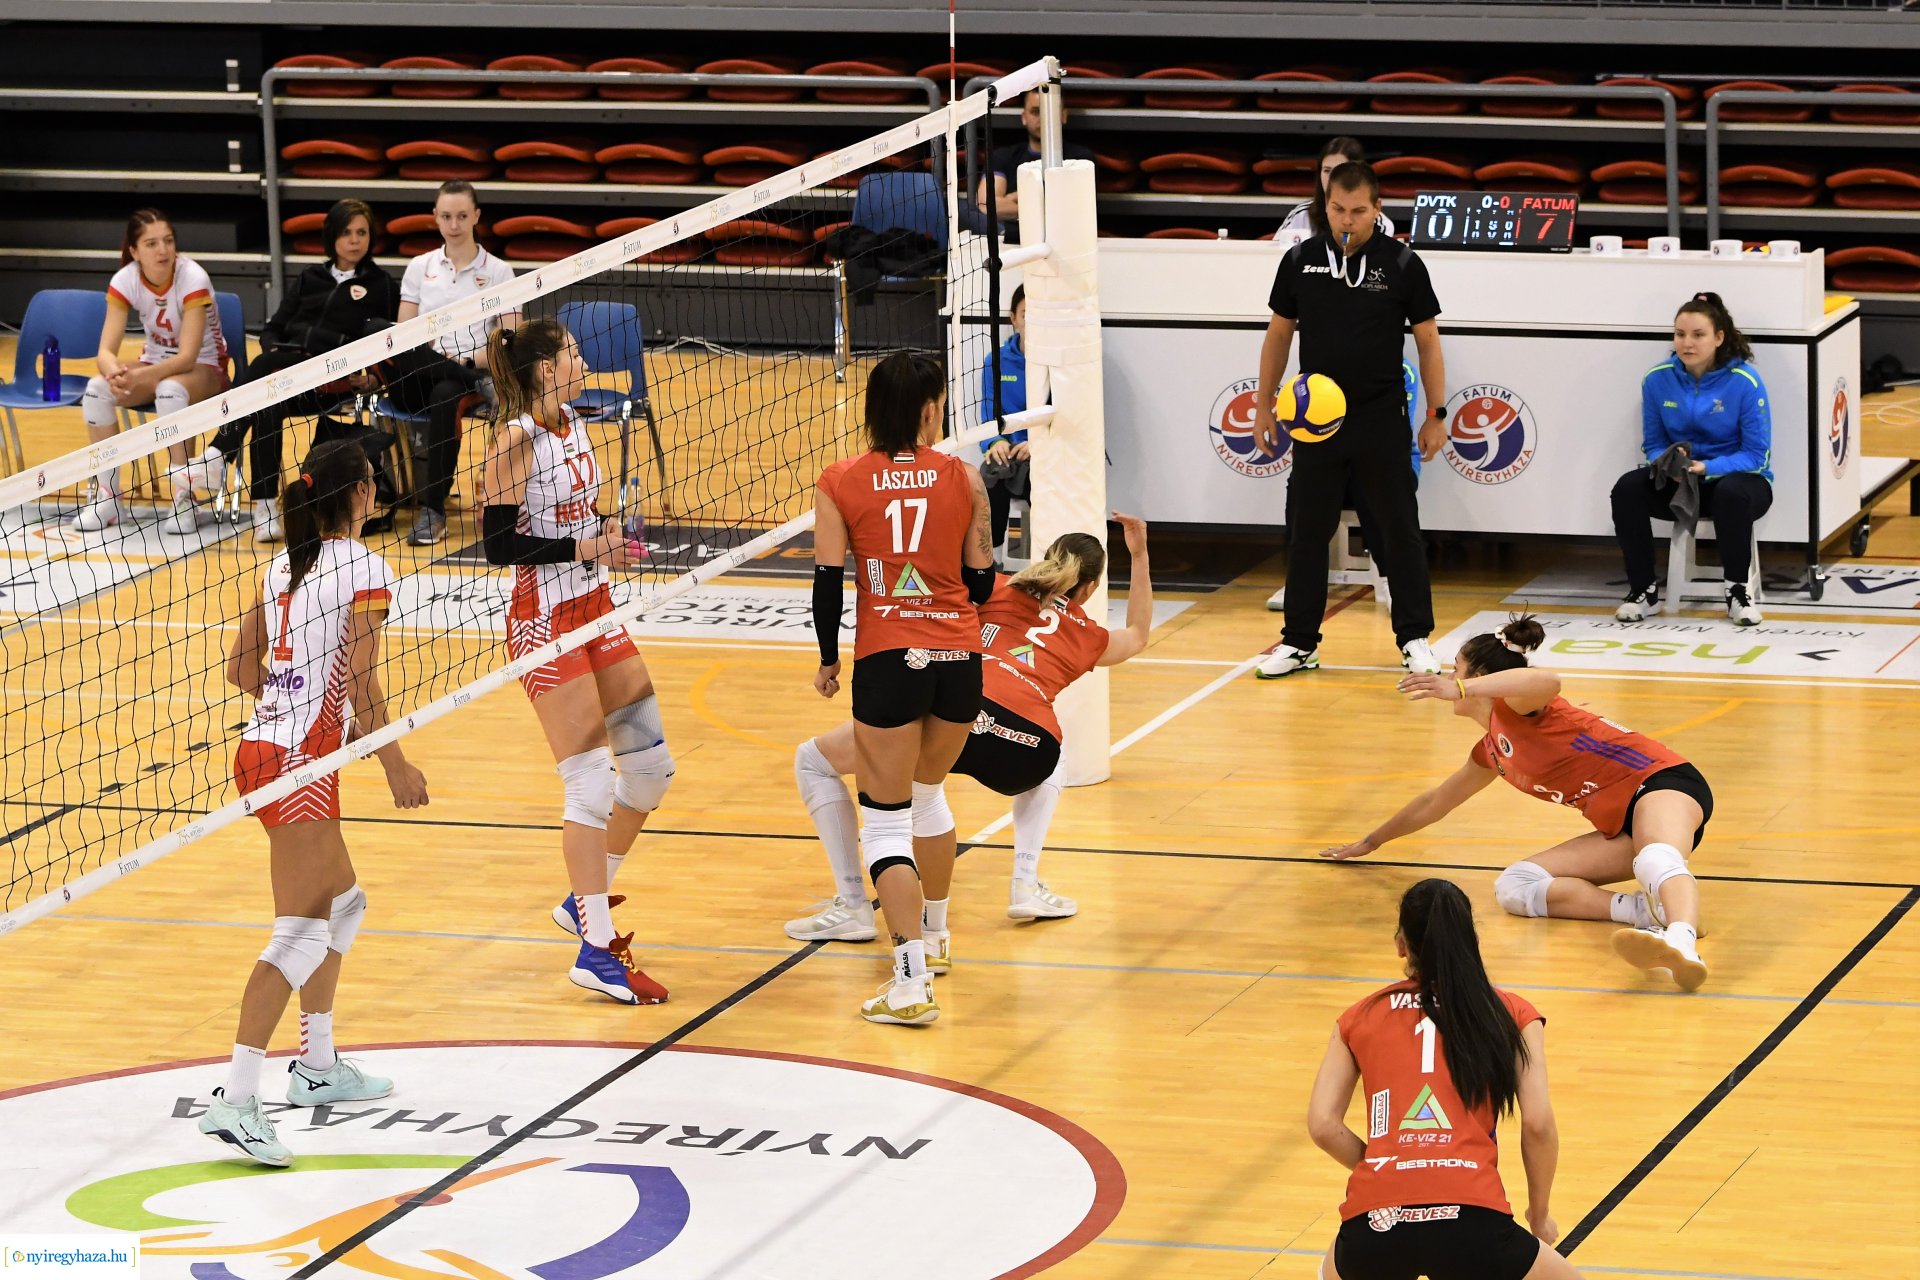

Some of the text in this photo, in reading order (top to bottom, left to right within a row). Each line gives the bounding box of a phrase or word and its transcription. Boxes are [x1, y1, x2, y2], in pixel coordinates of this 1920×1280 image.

[1416, 195, 1457, 207] DVTK
[1522, 198, 1575, 210] FATUM
[623, 240, 642, 255] FATUM
[1302, 264, 1331, 274] Zeus
[480, 295, 501, 313] FATUM
[155, 308, 173, 333] 4
[325, 357, 348, 374] FATUM
[1462, 386, 1512, 402] FATUM
[154, 424, 179, 442] FATUM
[563, 452, 594, 492] 17
[884, 498, 928, 554] 17
[899, 610, 960, 619] BESTRONG
[1024, 608, 1060, 648] 2
[1550, 638, 1770, 665] hsa
[118, 858, 140, 876] FATUM
[1415, 1016, 1436, 1074] 1
[1376, 1093, 1385, 1136] STRABAG
[1398, 1133, 1452, 1144] KE-VIZ 21
[1395, 1159, 1479, 1171] BESTRONG
[1400, 1206, 1459, 1221] REVESZ
